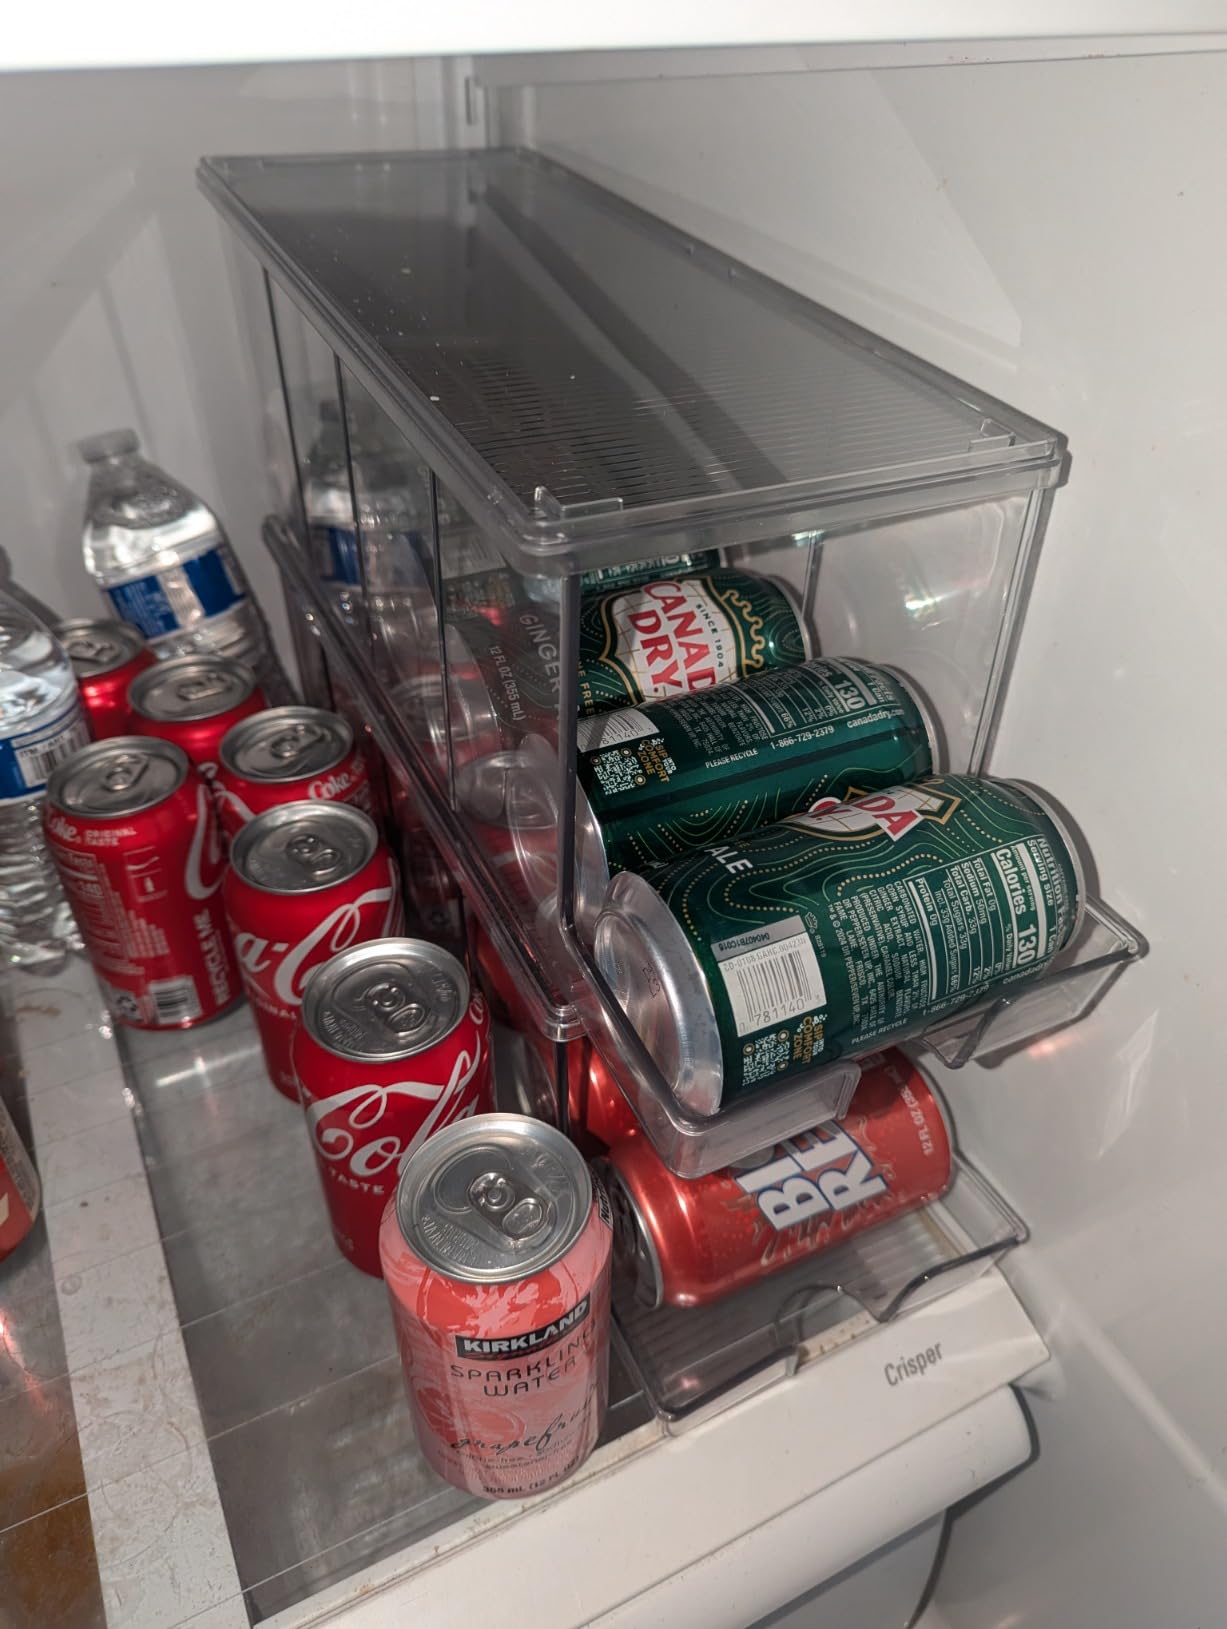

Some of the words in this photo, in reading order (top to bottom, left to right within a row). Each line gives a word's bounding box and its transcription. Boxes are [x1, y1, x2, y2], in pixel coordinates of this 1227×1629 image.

[643, 581, 716, 690] CANAD
[696, 603, 720, 640] SINCE
[714, 639, 725, 669] 1904
[489, 645, 503, 656] 12
[498, 666, 513, 679] OZ
[520, 614, 561, 693] GINGER
[580, 682, 595, 715] FREE
[835, 680, 866, 710] 130
[781, 713, 793, 728] 66%
[801, 707, 814, 722] 12%
[846, 708, 905, 728] canadadry.com
[655, 744, 668, 758] SIP
[770, 725, 835, 750] 1-866-729-2379
[637, 750, 656, 775] ZONE
[641, 740, 670, 783] COMFORT
[705, 756, 731, 769] PLEASE
[730, 749, 759, 763] RECYCLE
[704, 846, 754, 874] ALE
[972, 857, 987, 880] Total
[982, 880, 994, 897] Fat
[1027, 839, 1048, 881] Serving
[1043, 884, 1053, 906] size
[1037, 837, 1064, 904] Nutrition
[869, 889, 884, 912] CITRIC
[877, 886, 894, 912] GINGER
[885, 883, 899, 903] CORN
[894, 880, 916, 924] CARBONATED
[914, 878, 934, 912] Protein
[929, 913, 938, 926] 0g
[950, 865, 964, 889] Total
[960, 889, 974, 915] Carb.
[968, 917, 977, 935] 33g
[961, 862, 980, 897] Sodium
[976, 899, 987, 924] 50mg
[995, 848, 1027, 915] Calories
[1016, 924, 1038, 966] 130
[834, 901, 848, 921] FAME
[895, 905, 909, 928] SYRUP
[940, 907, 950, 924] 33g
[943, 879, 955, 899] Total
[951, 899, 964, 932] Sugars
[959, 933, 967, 949] 33g
[835, 928, 847, 946] 2024
[842, 898, 853, 909] DR
[848, 910, 870, 959] PEPPER/SEVEN
[850, 895, 871, 931] PRODUCED
[867, 935, 880, 959] UNDER
[874, 963, 883, 978] THE
[904, 932, 914, 947] AND
[908, 949, 918, 968] LESS
[802, 1016, 813, 1064] COMFORT
[910, 1108, 925, 1126] OZ
[788, 1119, 888, 1211] RE
[921, 1141, 934, 1156] 12
[731, 1150, 832, 1231] BI
[463, 1300, 588, 1353] KIRKLAND
[483, 1356, 577, 1397] WATER
[884, 1342, 942, 1386] Crisper
